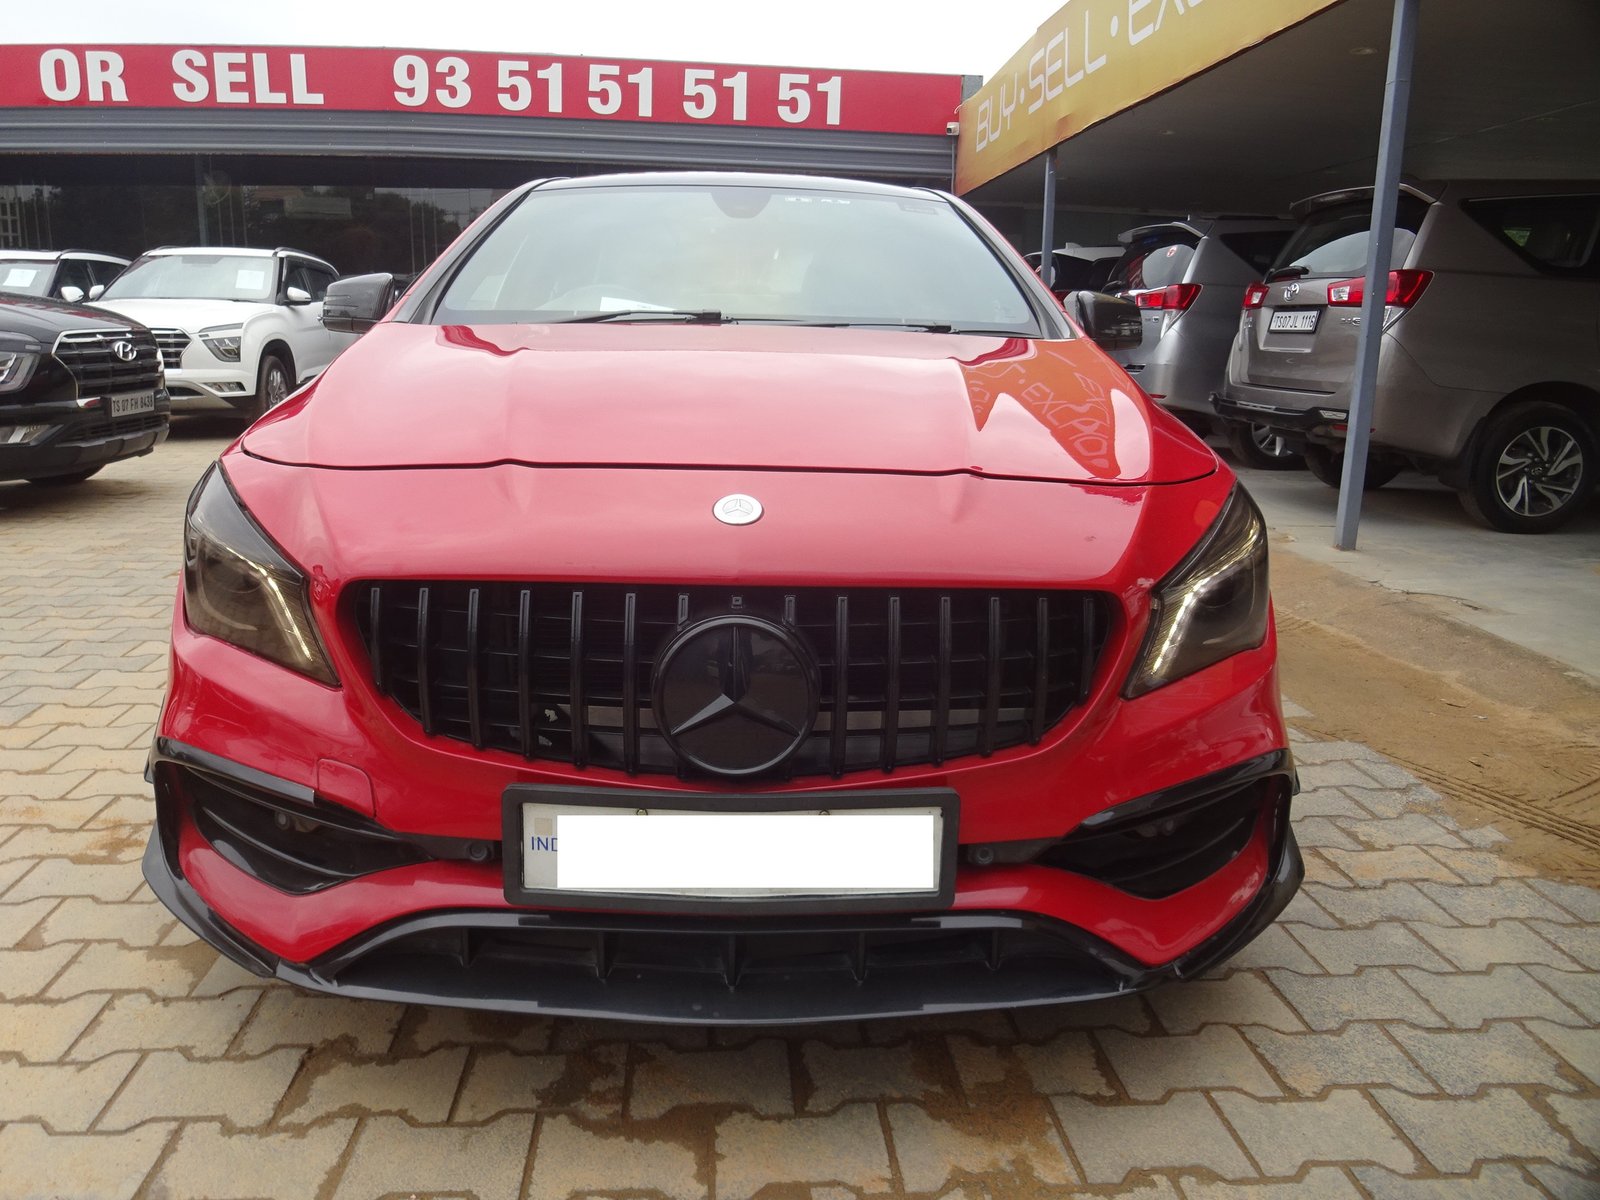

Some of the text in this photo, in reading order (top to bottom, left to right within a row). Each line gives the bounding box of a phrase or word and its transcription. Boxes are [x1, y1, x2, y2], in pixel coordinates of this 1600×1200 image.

[39, 48, 842, 126] OR SELL 93 51 51 51 51
